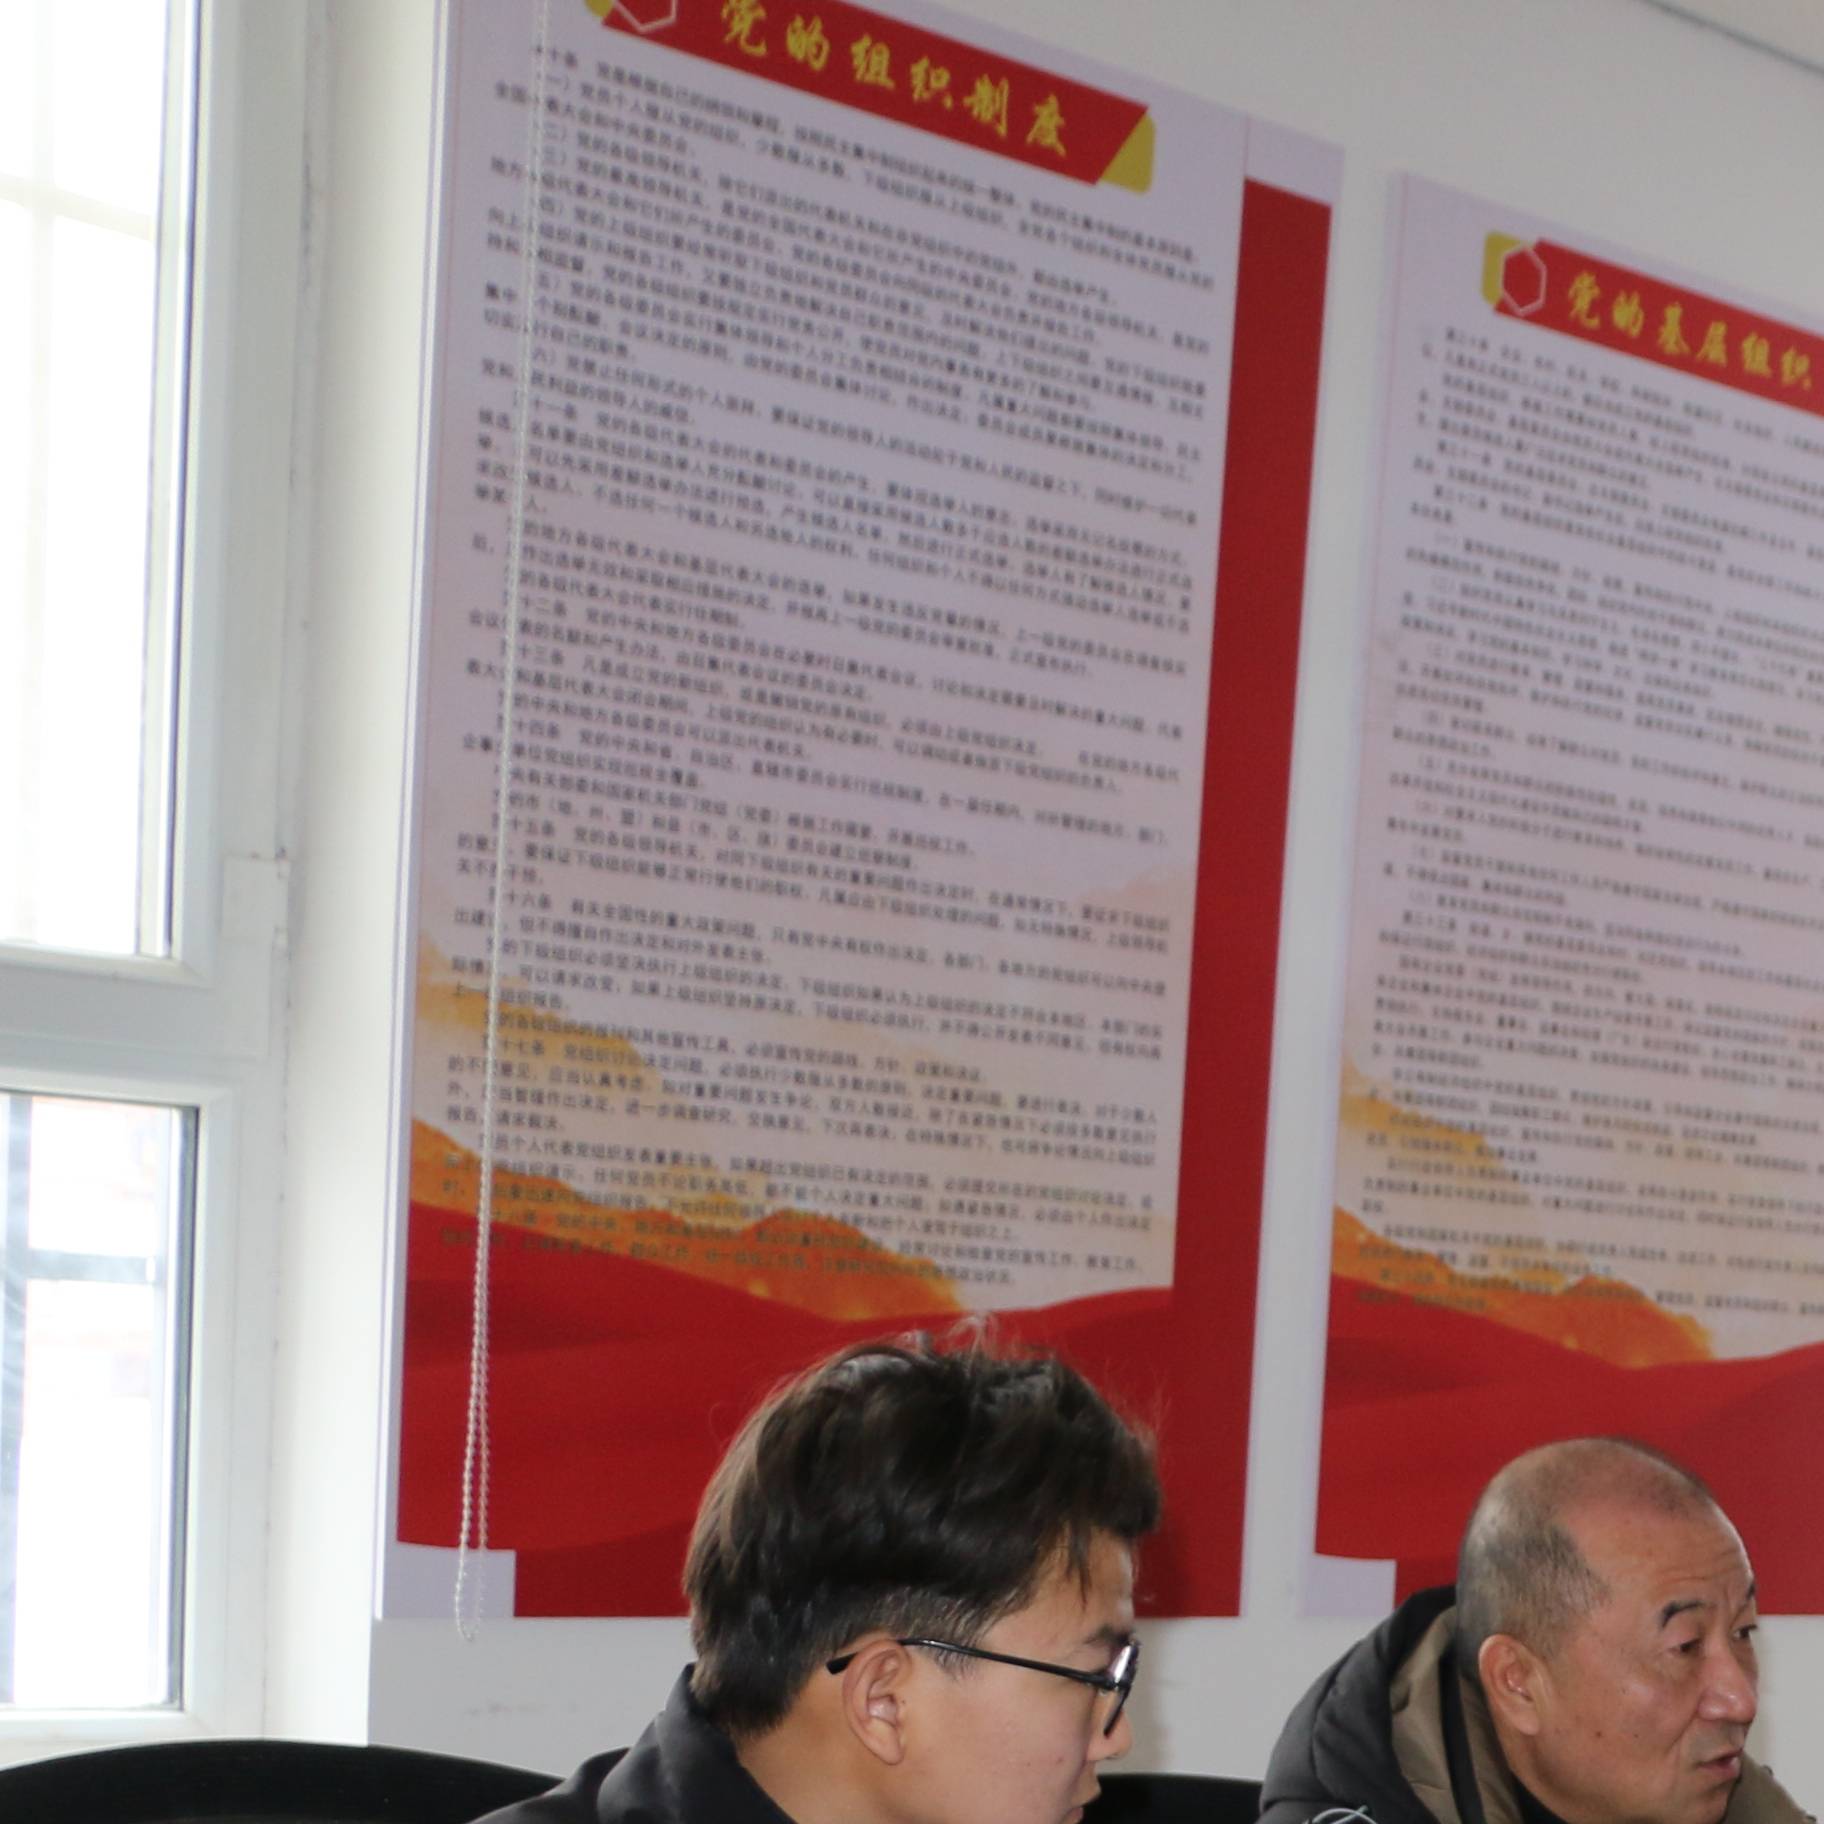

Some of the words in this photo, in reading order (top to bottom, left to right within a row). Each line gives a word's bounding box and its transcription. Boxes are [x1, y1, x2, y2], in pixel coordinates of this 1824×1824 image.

[721, 0, 1066, 156] 党的组织制度
[1567, 270, 1812, 391] 党的基层组织
